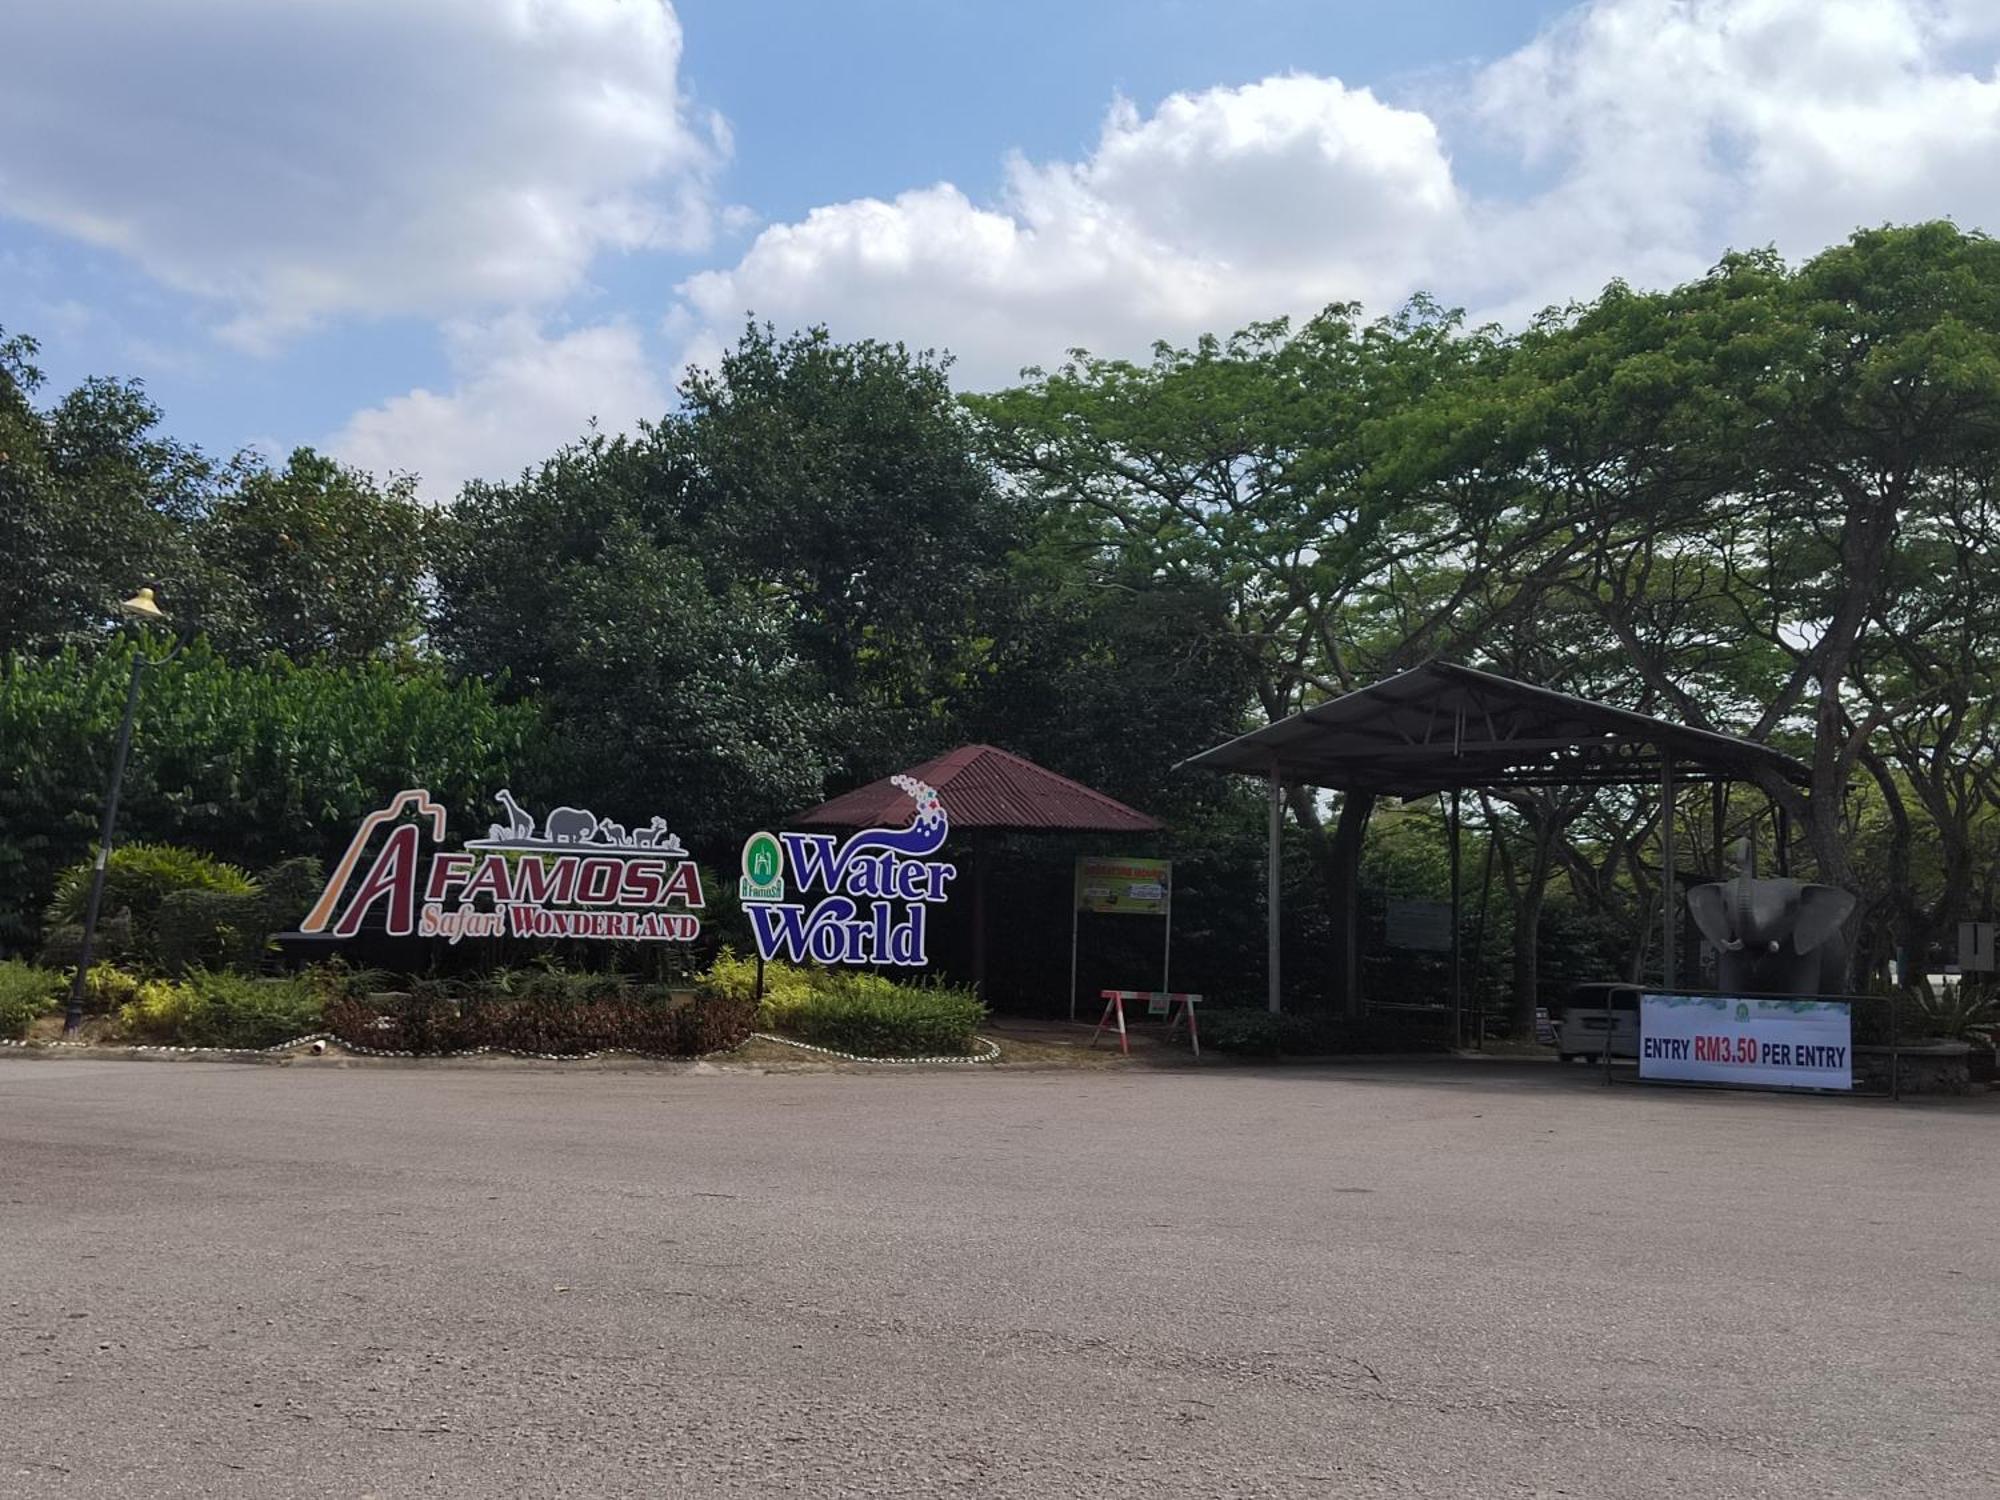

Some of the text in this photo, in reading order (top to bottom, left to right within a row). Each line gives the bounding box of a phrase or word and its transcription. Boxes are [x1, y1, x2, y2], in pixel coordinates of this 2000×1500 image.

[425, 853, 705, 908] FAMOSA
[779, 828, 957, 901] Water
[419, 903, 700, 943] Safari WONDERLAND
[742, 896, 929, 965] World
[1644, 1035, 1846, 1068] ENTRY RM3.50 PER ENTRY
